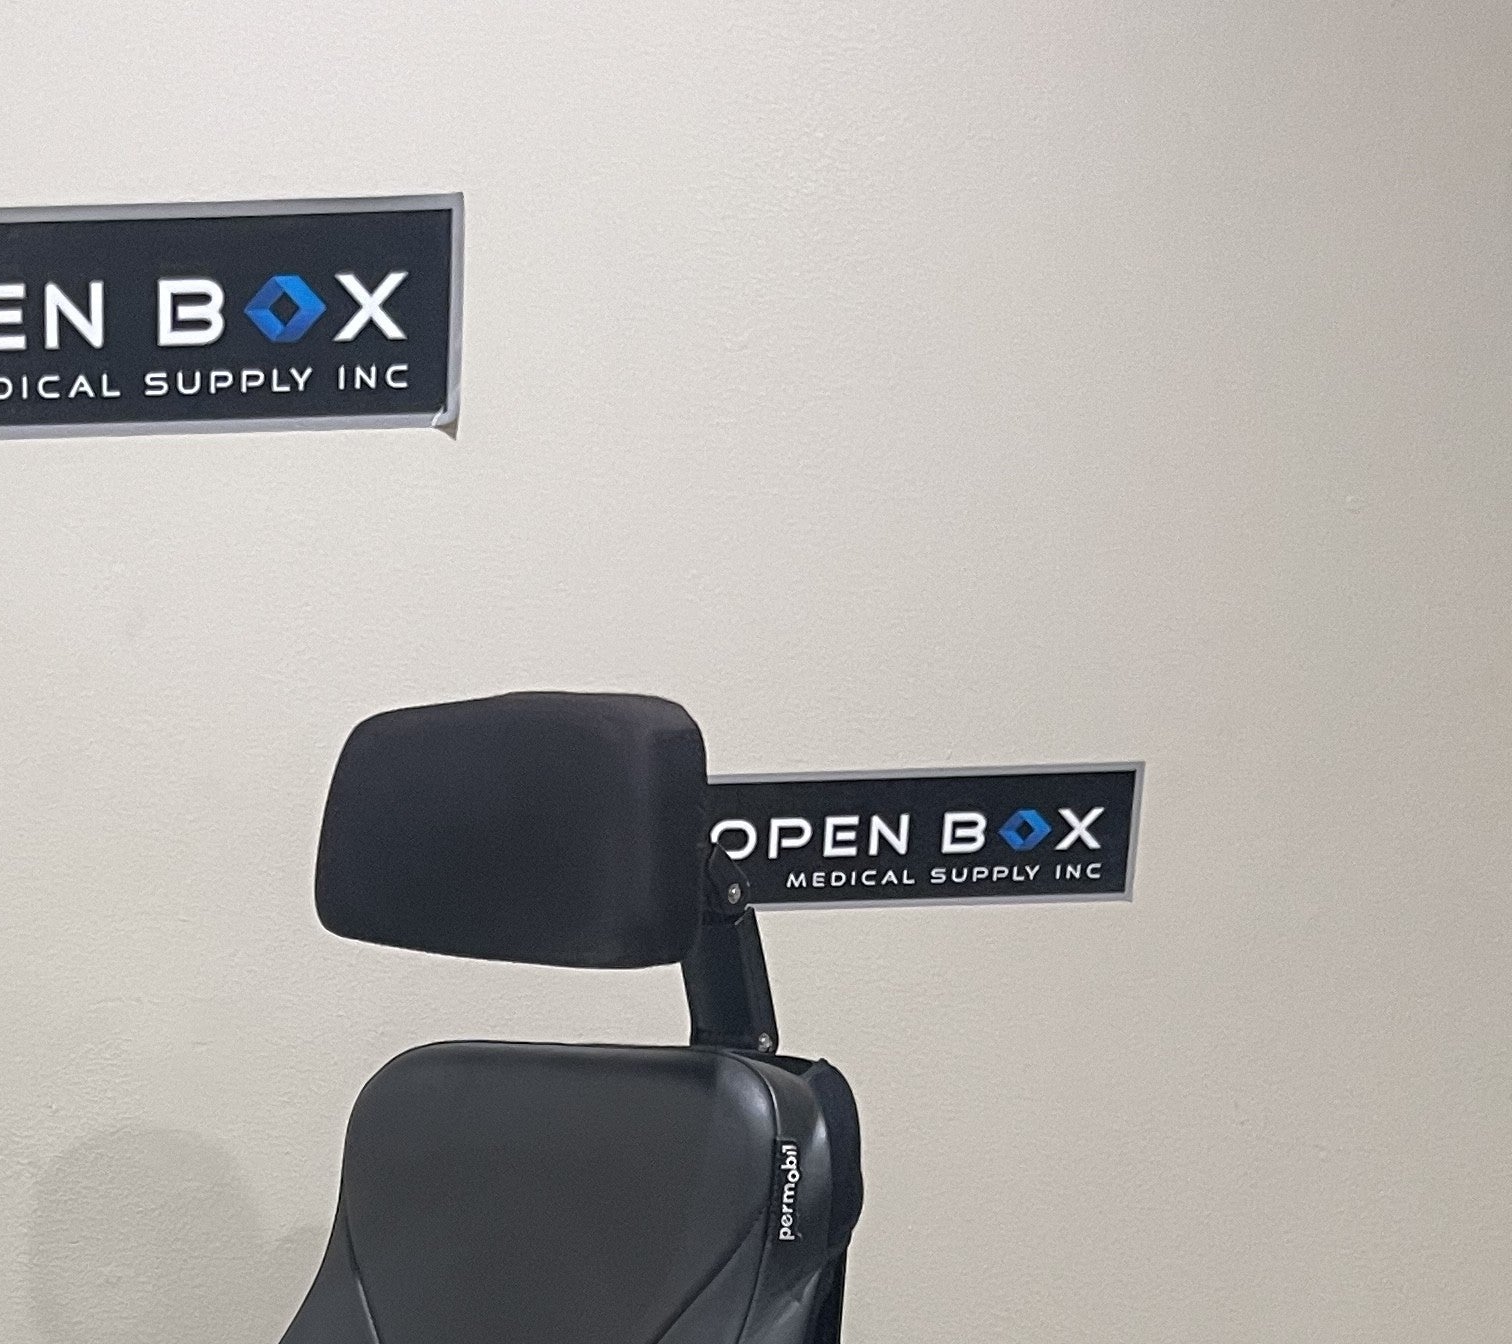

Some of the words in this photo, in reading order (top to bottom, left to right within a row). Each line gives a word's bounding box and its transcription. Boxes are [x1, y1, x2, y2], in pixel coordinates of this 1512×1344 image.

[157, 270, 409, 348] BOX
[143, 366, 313, 397] SUPPLY
[337, 362, 409, 391] INC
[709, 812, 911, 861] OPEN
[941, 805, 1106, 855] BOX
[786, 868, 916, 889] MEDICAL
[929, 863, 1040, 885] SUPPLY
[1054, 862, 1103, 881] INC
[778, 1144, 800, 1241] permobil
